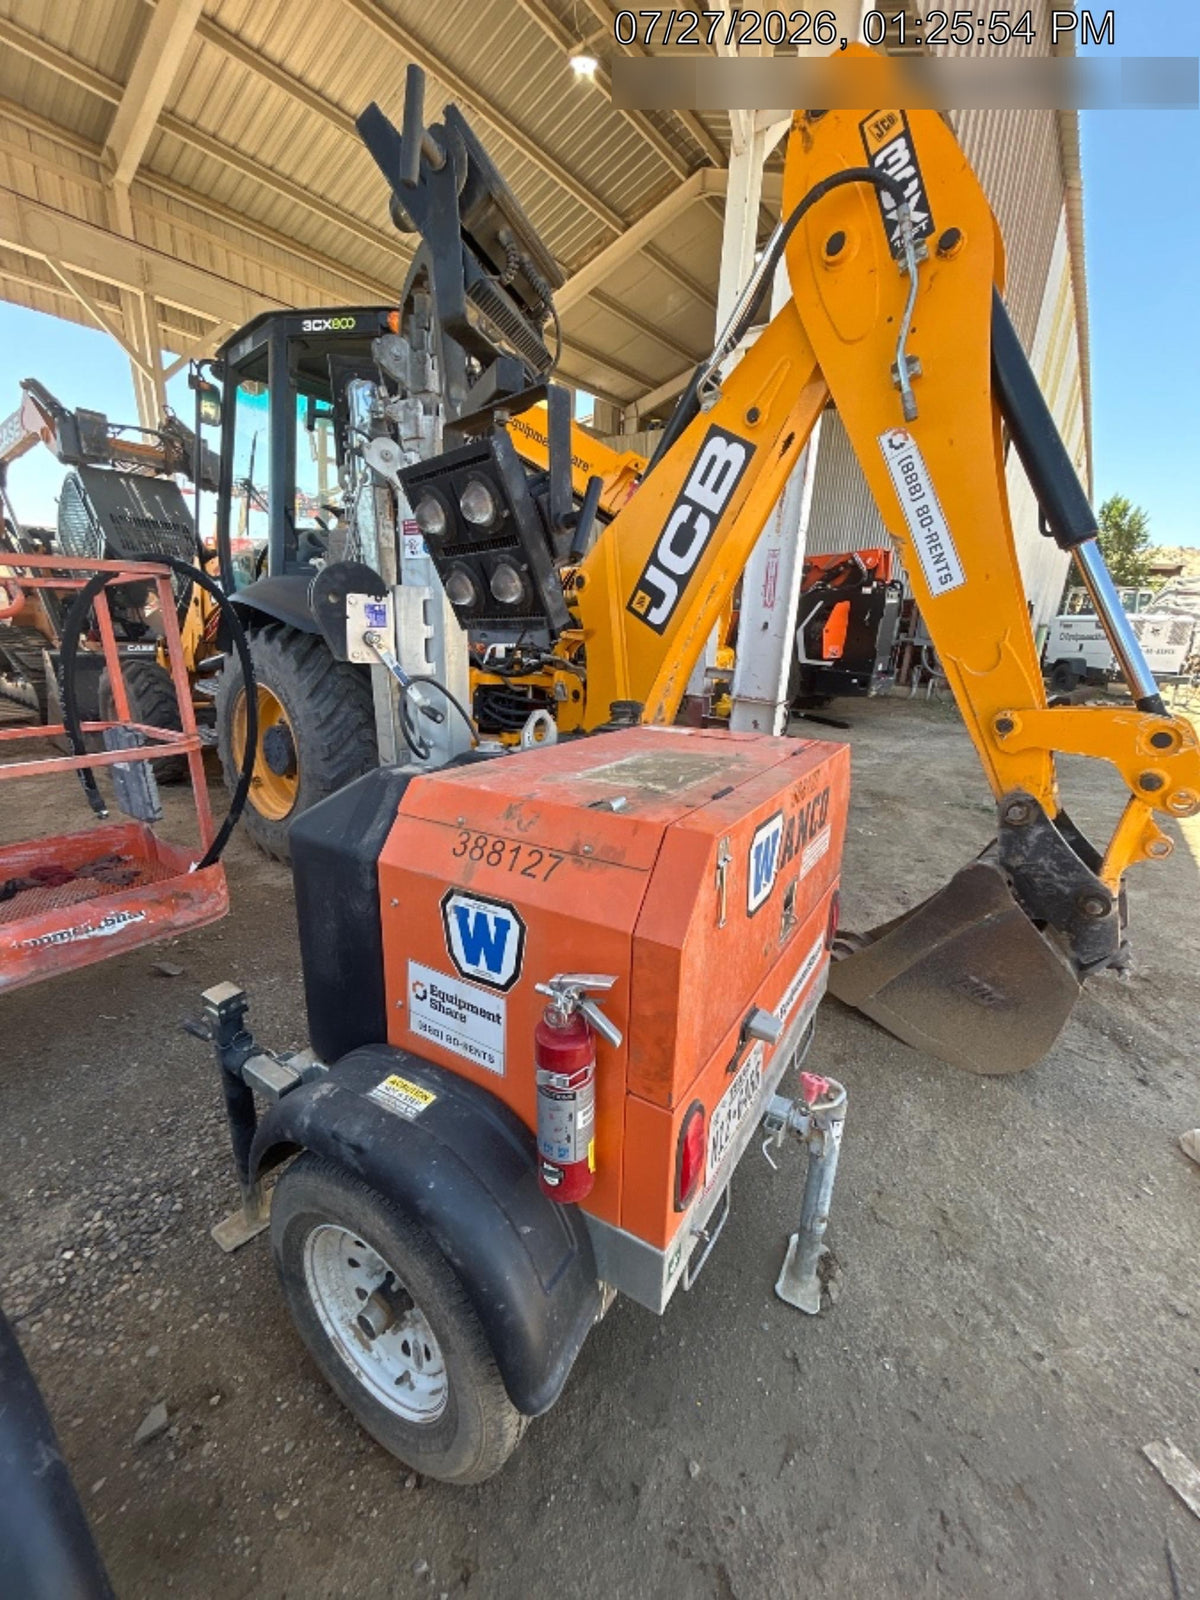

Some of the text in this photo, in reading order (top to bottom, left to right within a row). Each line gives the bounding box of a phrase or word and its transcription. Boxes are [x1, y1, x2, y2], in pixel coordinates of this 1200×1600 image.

[873, 112, 897, 140] JCB
[644, 436, 746, 625] JCB
[898, 454, 954, 586] (888) 80-RENTS
[452, 831, 564, 882] 388127
[453, 904, 511, 975] W
[429, 983, 502, 1025] Equipment
[429, 997, 467, 1023] Share
